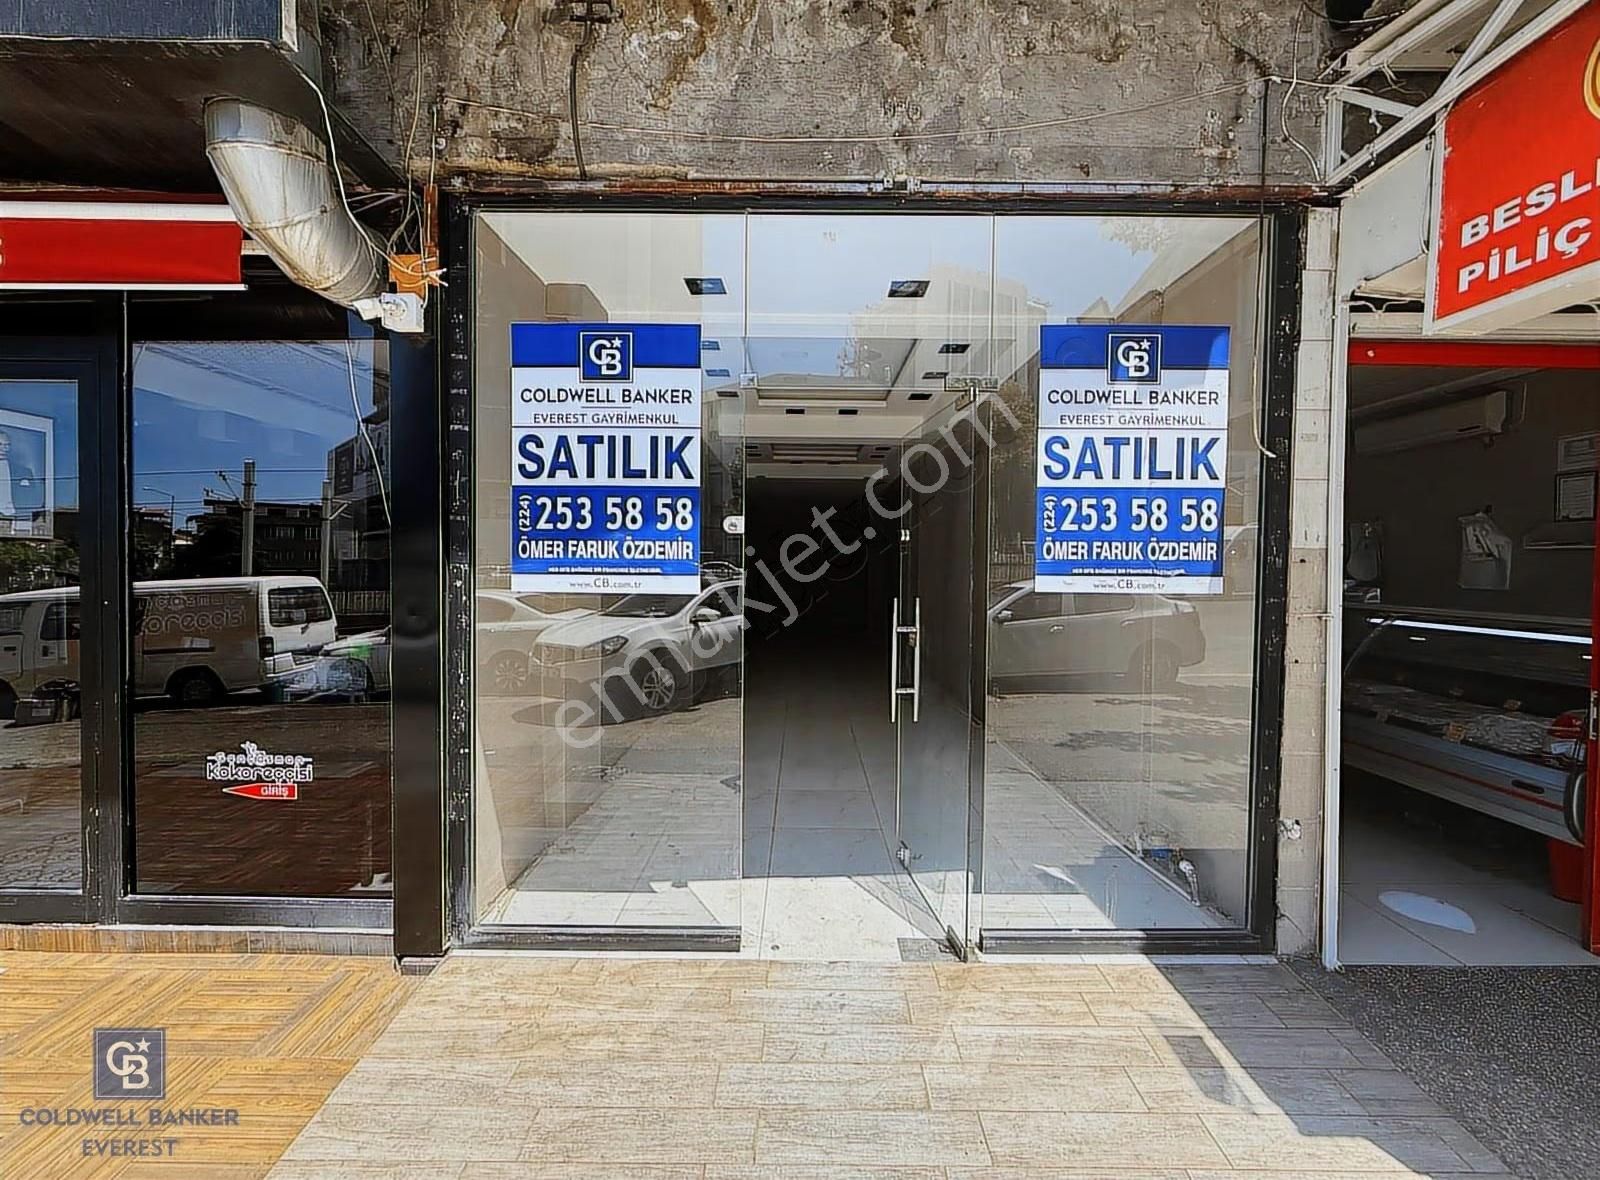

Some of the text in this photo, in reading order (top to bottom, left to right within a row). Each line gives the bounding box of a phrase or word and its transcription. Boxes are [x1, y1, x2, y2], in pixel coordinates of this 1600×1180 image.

[1458, 217, 1592, 294] PİLİÇ
[520, 388, 692, 404] COLDWELL BANKER
[1047, 389, 1219, 406] COLDWELL BANKER
[533, 411, 679, 425] EVEREST GAYRİMENKUL
[1060, 412, 1206, 426] EVEREST GAYRİMENKUL
[517, 434, 694, 479] SATILIK
[1043, 435, 1220, 480] SATILIK
[518, 494, 693, 532] (224) 253 58 58
[1043, 495, 1218, 533] (224) 253 58 58
[518, 534, 693, 560] ÖMER FARUK ÖZDEMİR
[1043, 536, 1217, 561] ÖMER FARUK ÖZDEMİR
[569, 577, 642, 588] www.CB.com.tr
[1093, 579, 1165, 589] www.CB.com.tr
